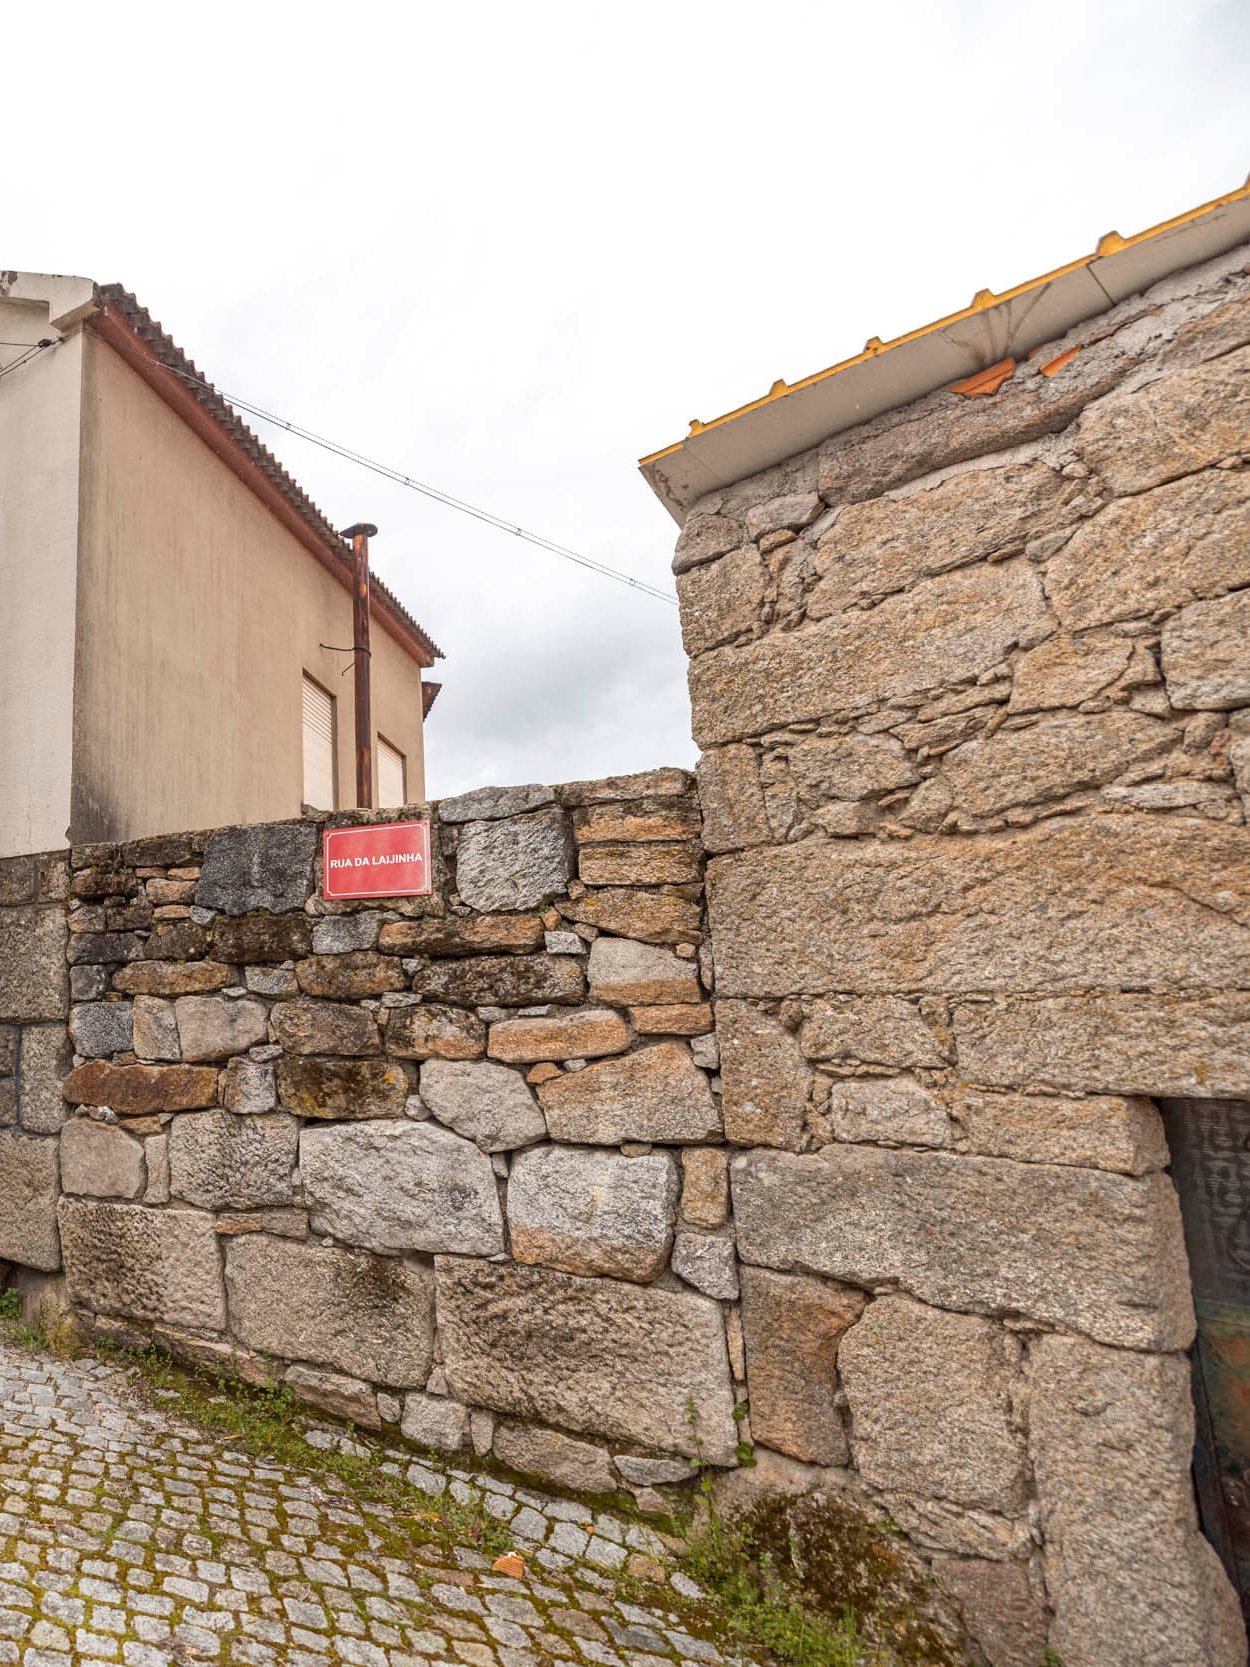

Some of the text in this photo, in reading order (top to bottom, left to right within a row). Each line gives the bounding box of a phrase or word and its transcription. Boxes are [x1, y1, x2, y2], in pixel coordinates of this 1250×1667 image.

[330, 852, 423, 869] RUA DA LAIJINHA
